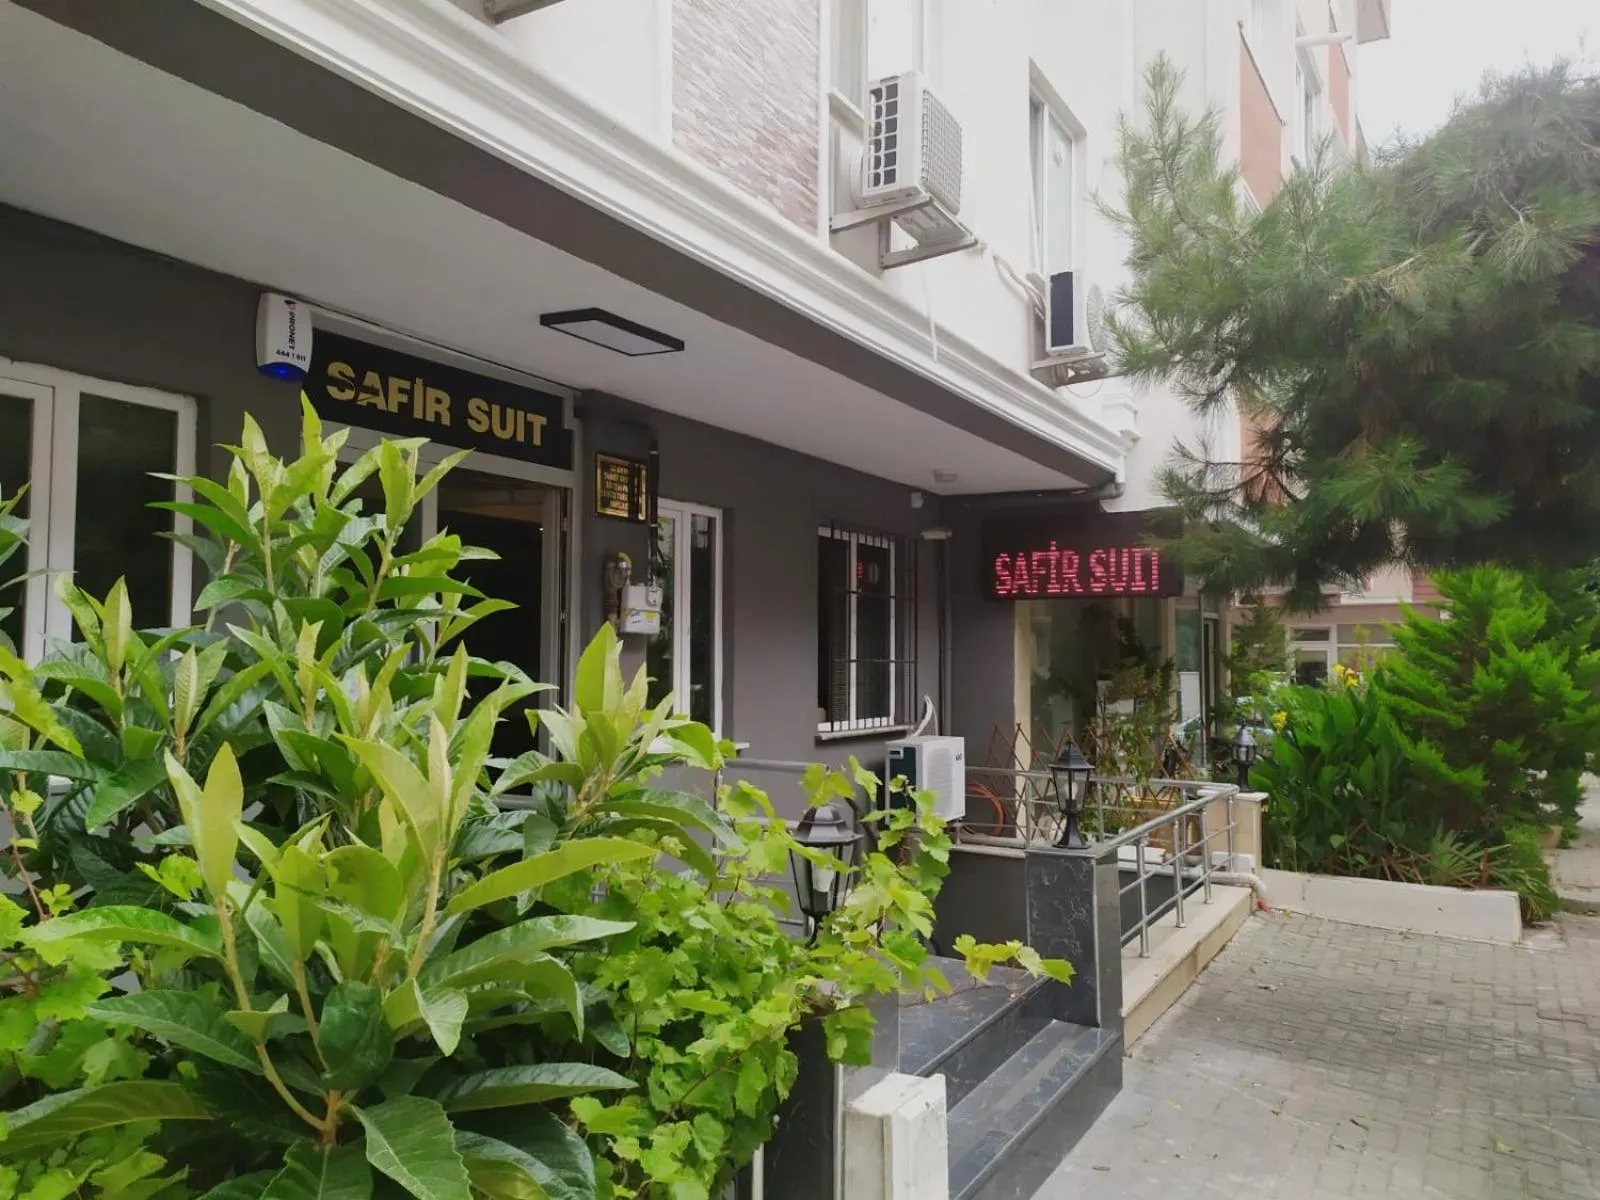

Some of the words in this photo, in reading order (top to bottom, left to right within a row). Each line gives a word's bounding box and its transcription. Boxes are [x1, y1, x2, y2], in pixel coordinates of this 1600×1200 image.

[326, 362, 451, 426] SAFİR
[467, 397, 548, 447] SUIT
[995, 541, 1084, 594] SAFİR
[1089, 549, 1161, 592] SUIT
